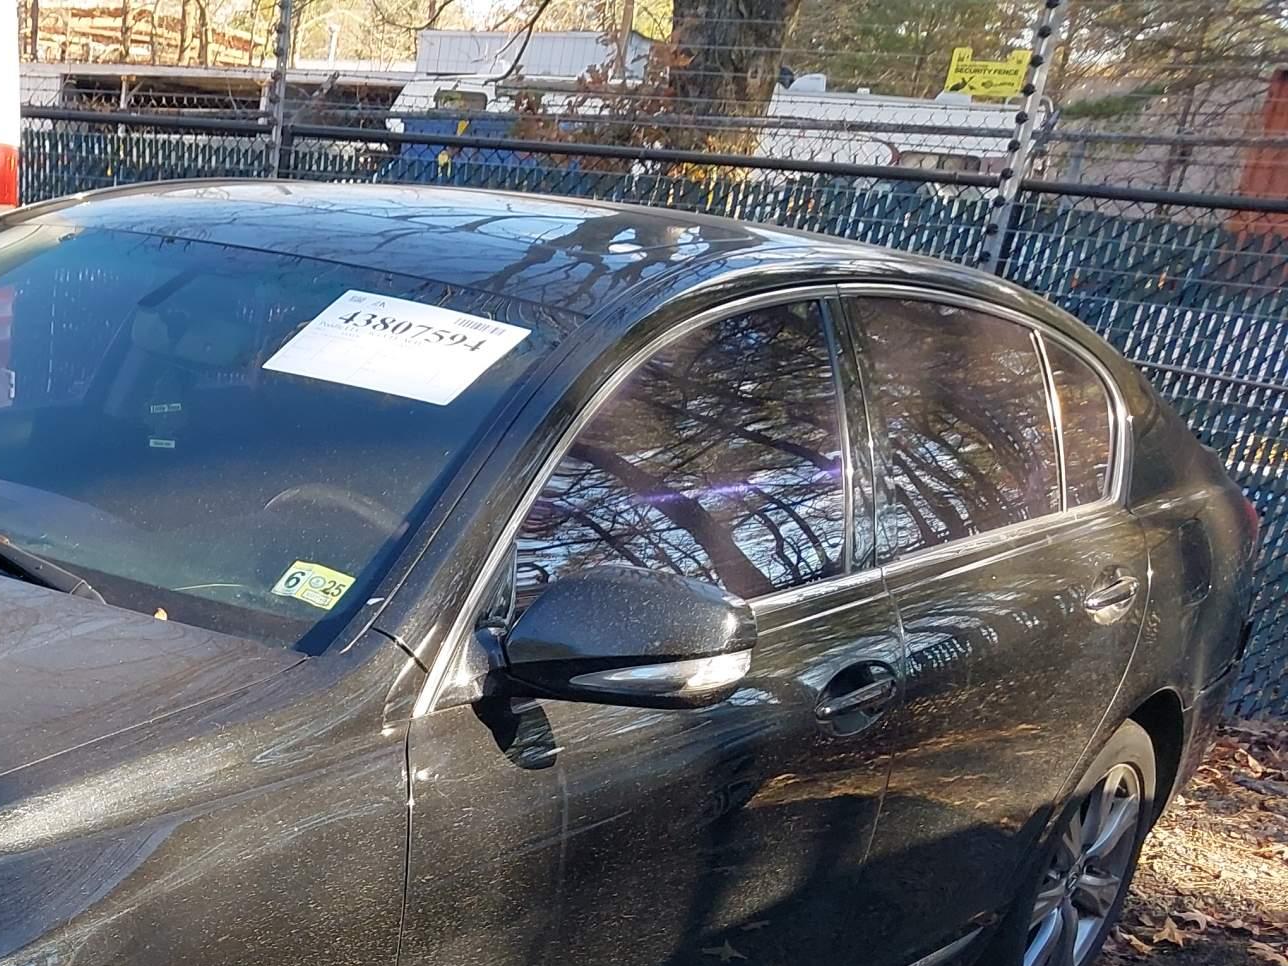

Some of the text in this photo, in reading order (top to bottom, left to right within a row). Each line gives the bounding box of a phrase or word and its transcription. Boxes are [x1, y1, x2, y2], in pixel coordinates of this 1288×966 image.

[954, 67, 1020, 76] SECURITY FENCE
[338, 309, 488, 352] 43807594
[284, 570, 306, 589] 6
[320, 580, 346, 598] 25
